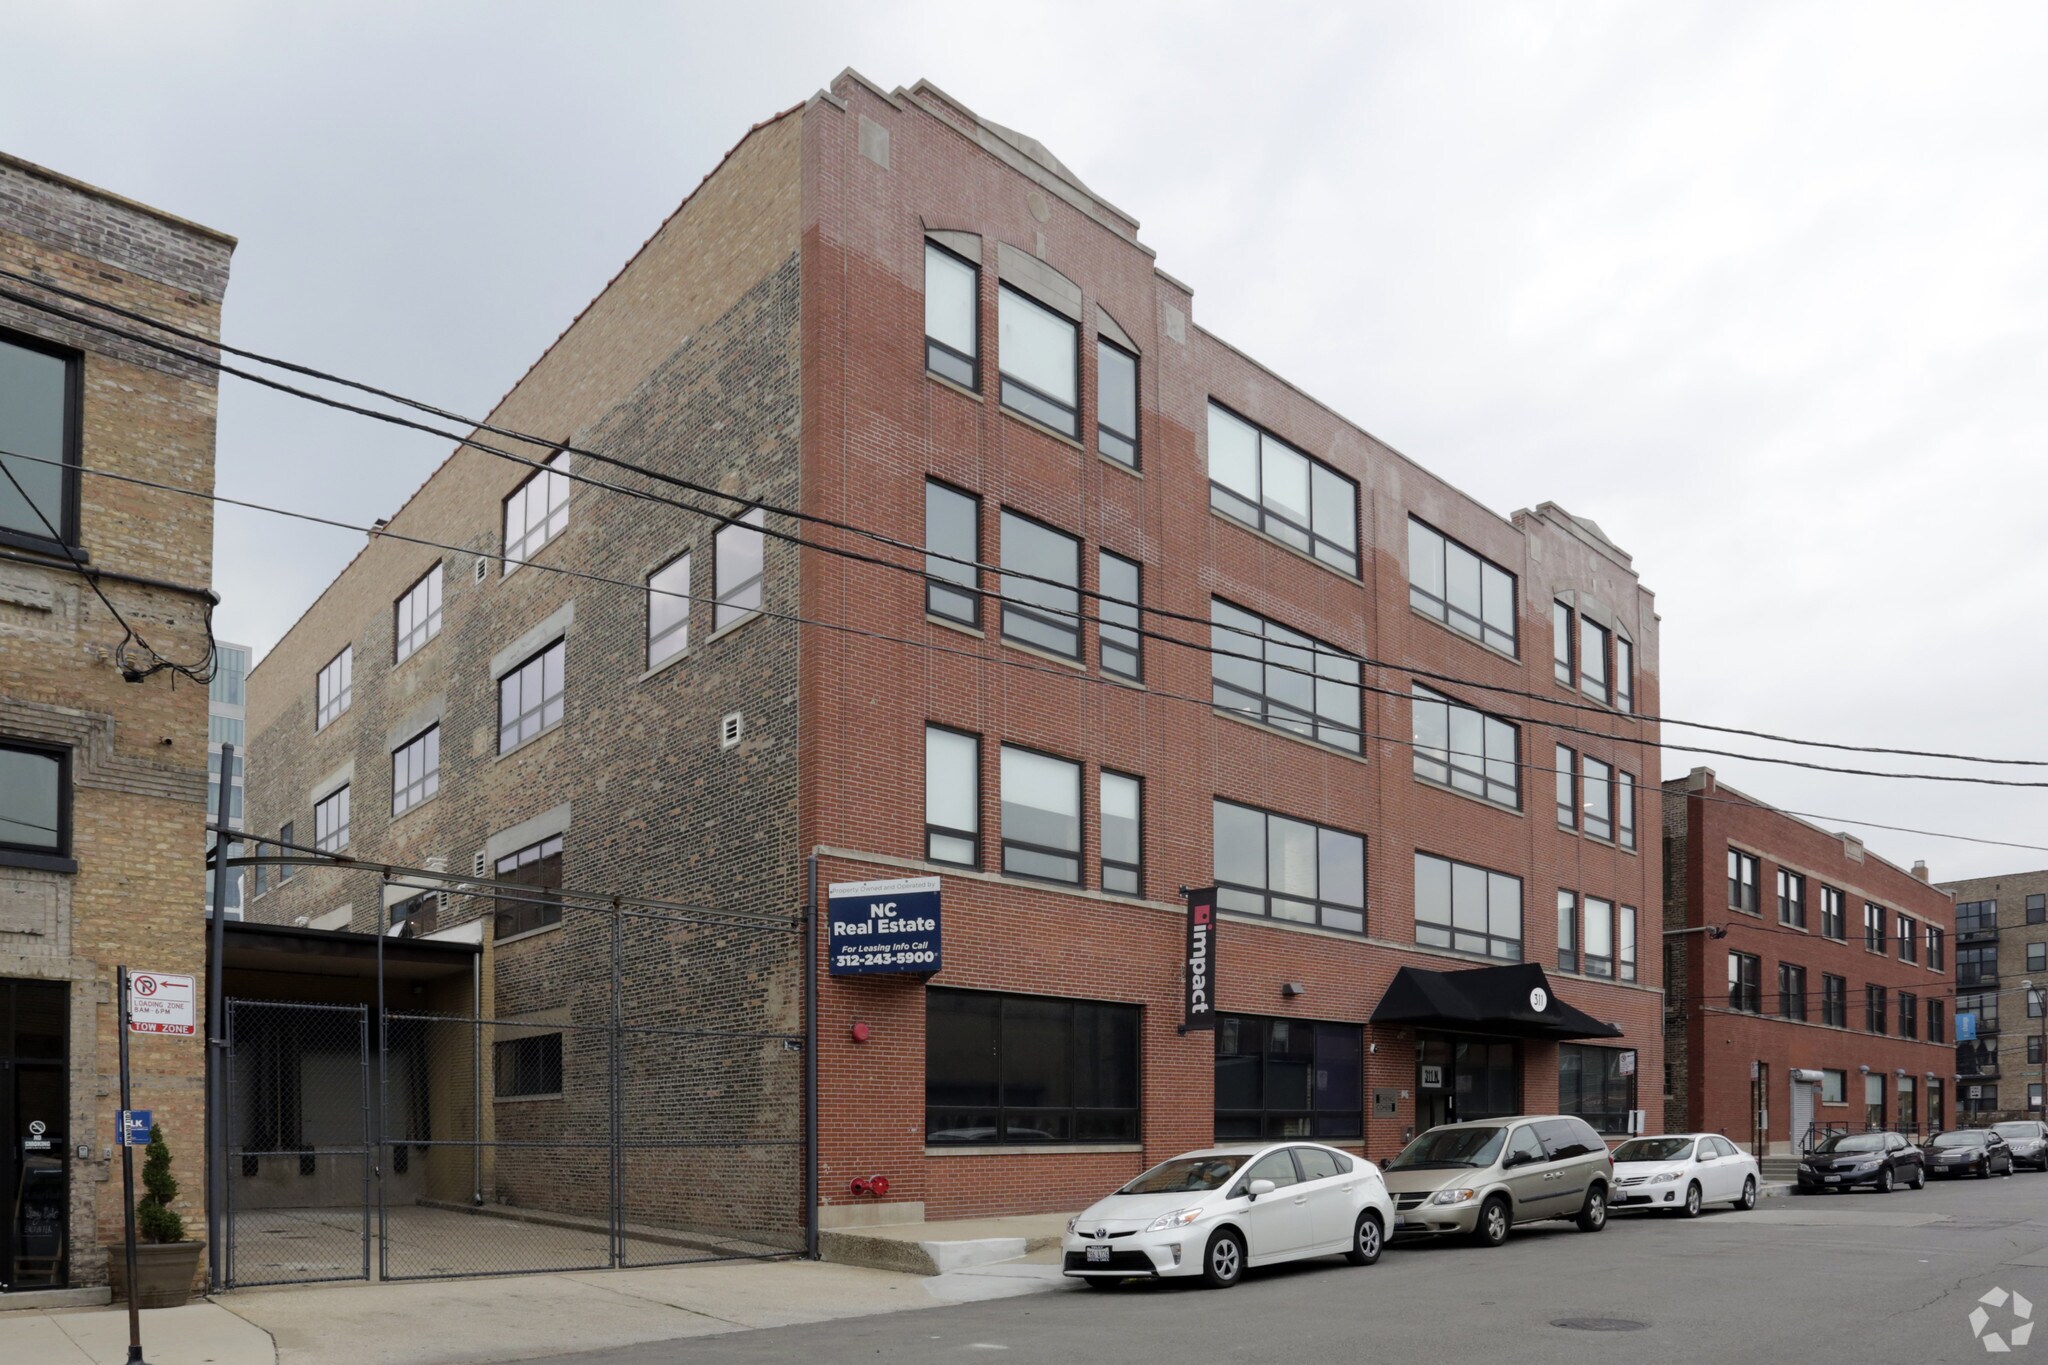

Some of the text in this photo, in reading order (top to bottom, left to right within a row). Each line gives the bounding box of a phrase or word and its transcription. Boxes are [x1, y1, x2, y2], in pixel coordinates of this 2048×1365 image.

[832, 887, 858, 896] Property
[884, 883, 896, 891] and
[897, 882, 926, 891] Operated
[927, 881, 935, 889] by
[870, 902, 897, 918] NC
[834, 917, 936, 936] Real Estate
[841, 941, 928, 953] For Leasing Info Call
[836, 951, 935, 967] 312-243-5900
[1189, 924, 1212, 1014] impact
[1534, 993, 1544, 1006] 311
[135, 1022, 189, 1034] TOW ZONE
